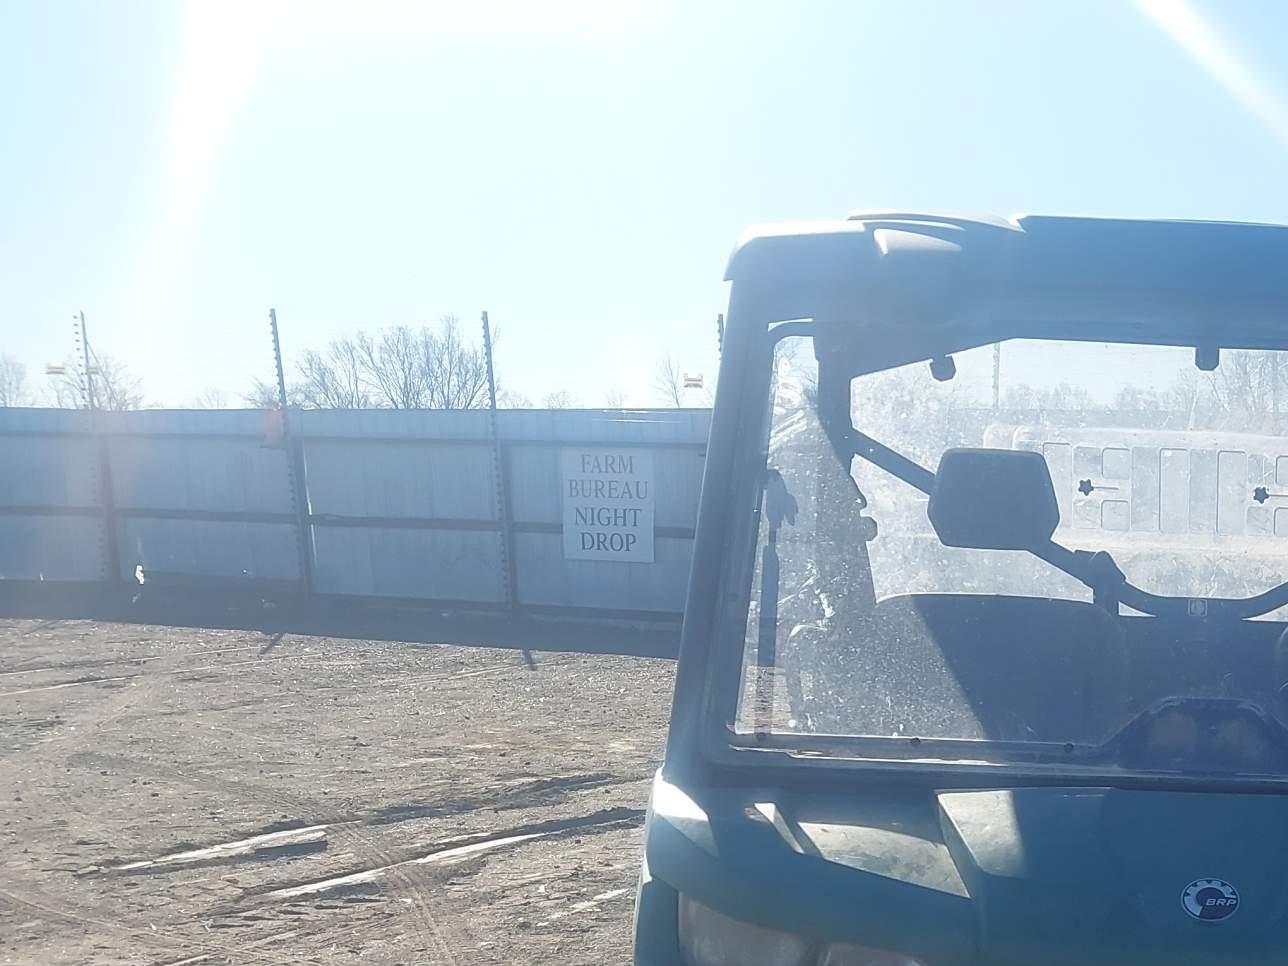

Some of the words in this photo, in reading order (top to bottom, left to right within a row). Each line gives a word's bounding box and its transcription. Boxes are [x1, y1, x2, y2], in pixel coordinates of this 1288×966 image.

[581, 454, 634, 474] FARM
[568, 479, 649, 500] BUREAU
[575, 507, 642, 527] NIGHT
[581, 532, 637, 552] DROP
[1206, 898, 1237, 906] BRP
